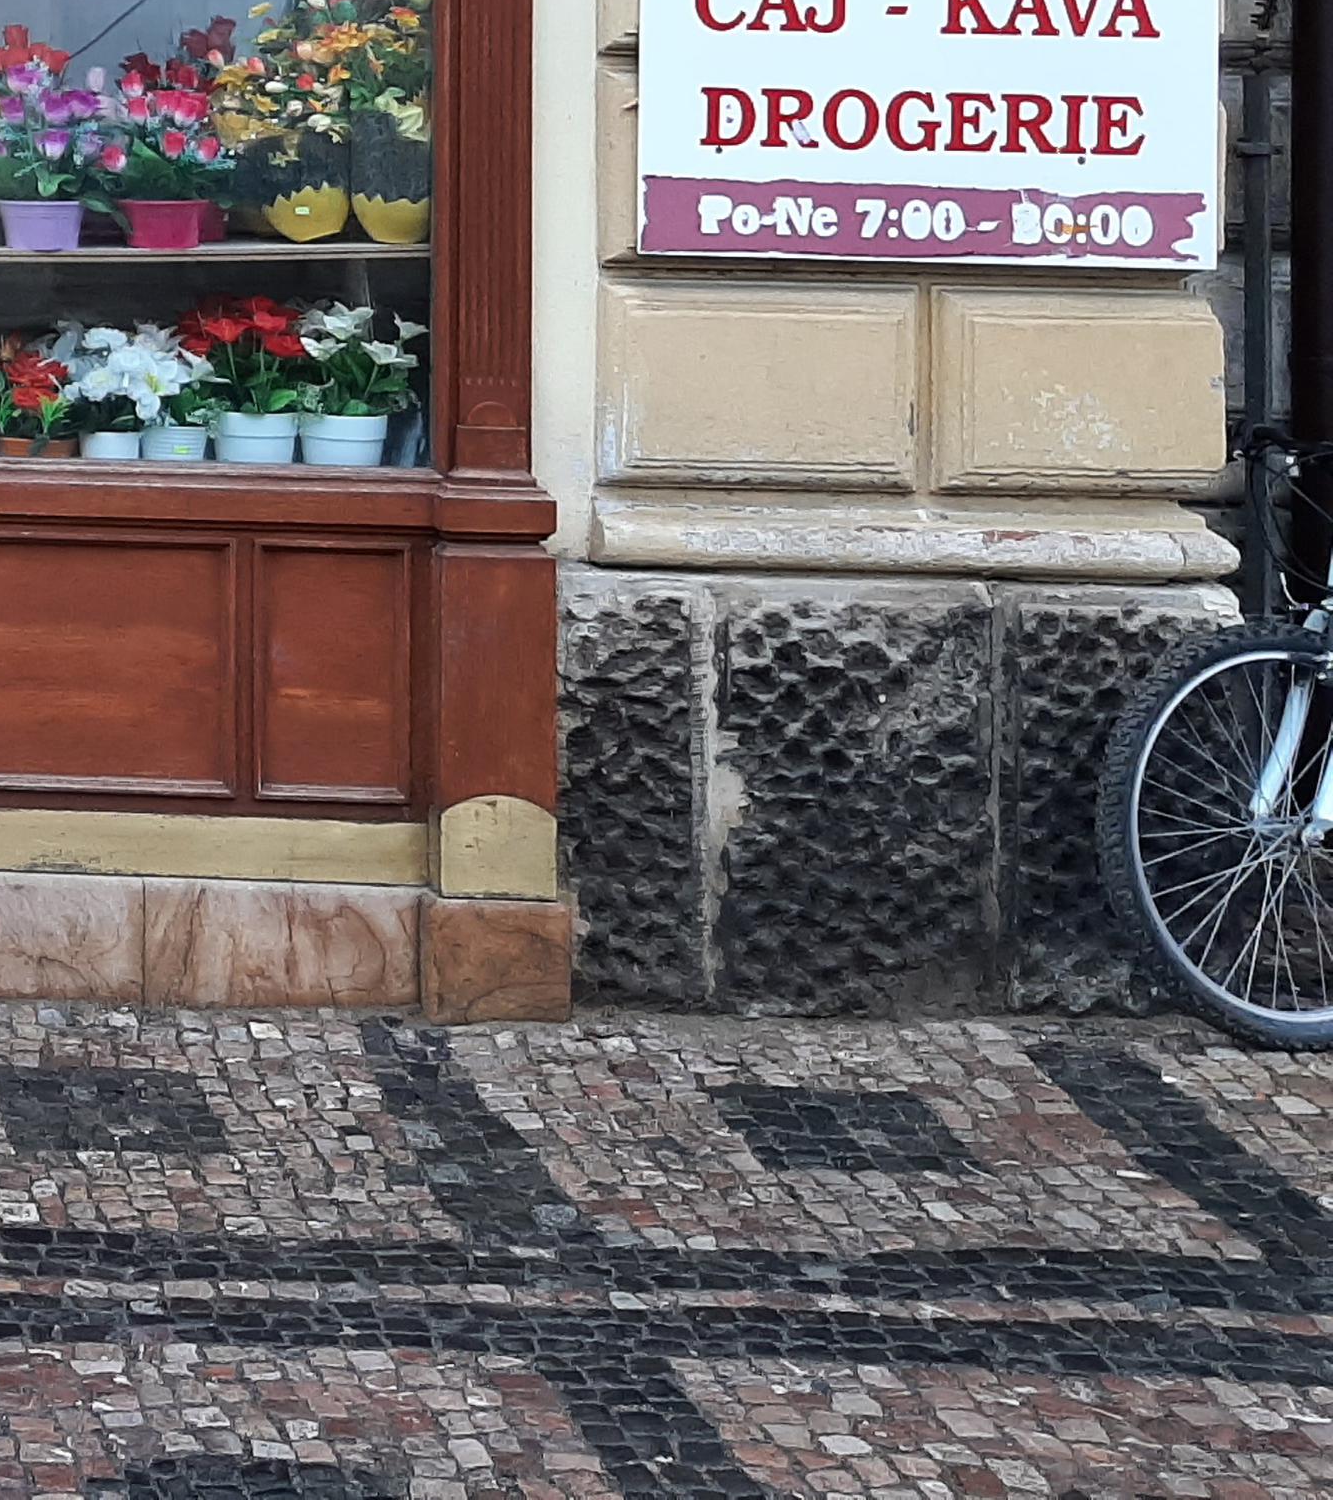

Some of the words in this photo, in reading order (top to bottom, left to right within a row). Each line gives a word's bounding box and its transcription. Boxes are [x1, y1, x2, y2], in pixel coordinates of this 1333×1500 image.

[699, 86, 1147, 156] DROGERIE
[698, 194, 839, 237] Po-Ne
[854, 198, 967, 242] 7:00
